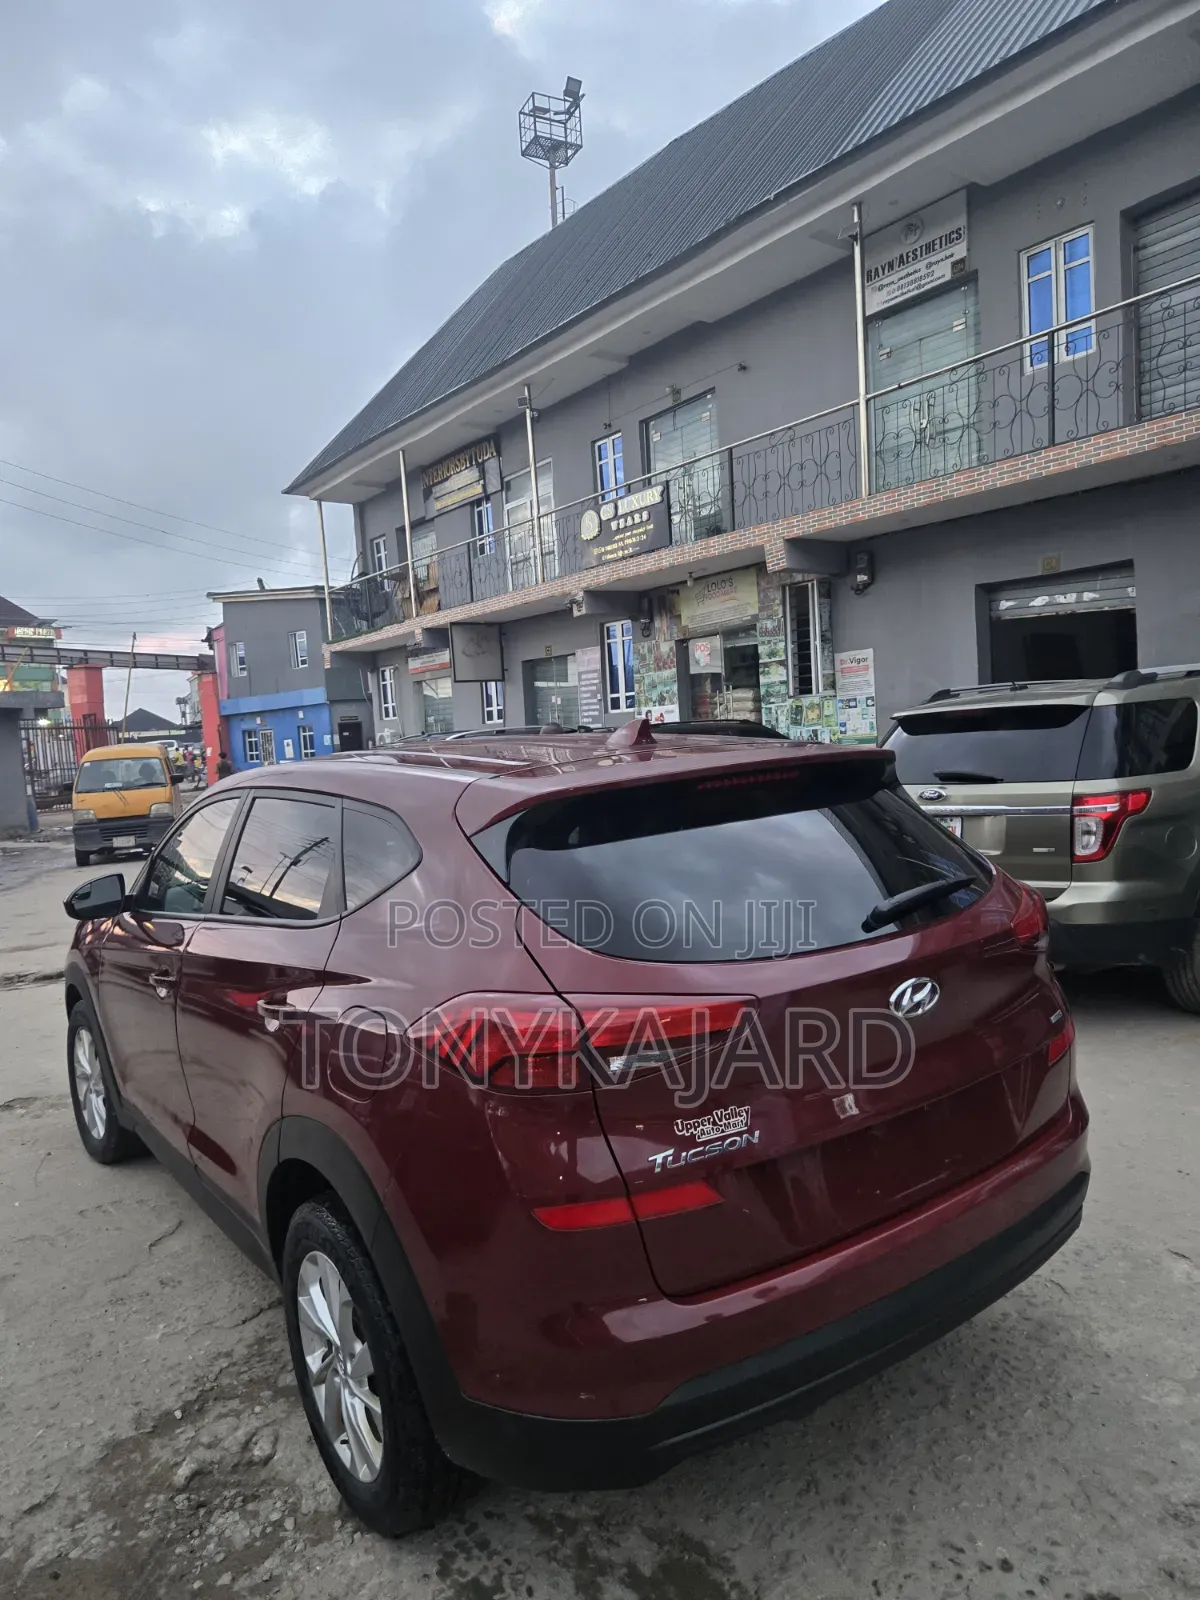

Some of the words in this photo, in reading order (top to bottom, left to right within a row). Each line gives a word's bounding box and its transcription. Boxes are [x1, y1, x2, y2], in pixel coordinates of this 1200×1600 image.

[617, 485, 665, 516] LUXURY
[610, 510, 650, 531] WEARS
[706, 577, 734, 593] LOLO'S
[695, 643, 710, 653] POS
[674, 1115, 713, 1136] Upper
[713, 1105, 751, 1127] Valley
[699, 1126, 721, 1138] Auto
[724, 1118, 747, 1132] Mart
[648, 1129, 760, 1174] TUCSON
